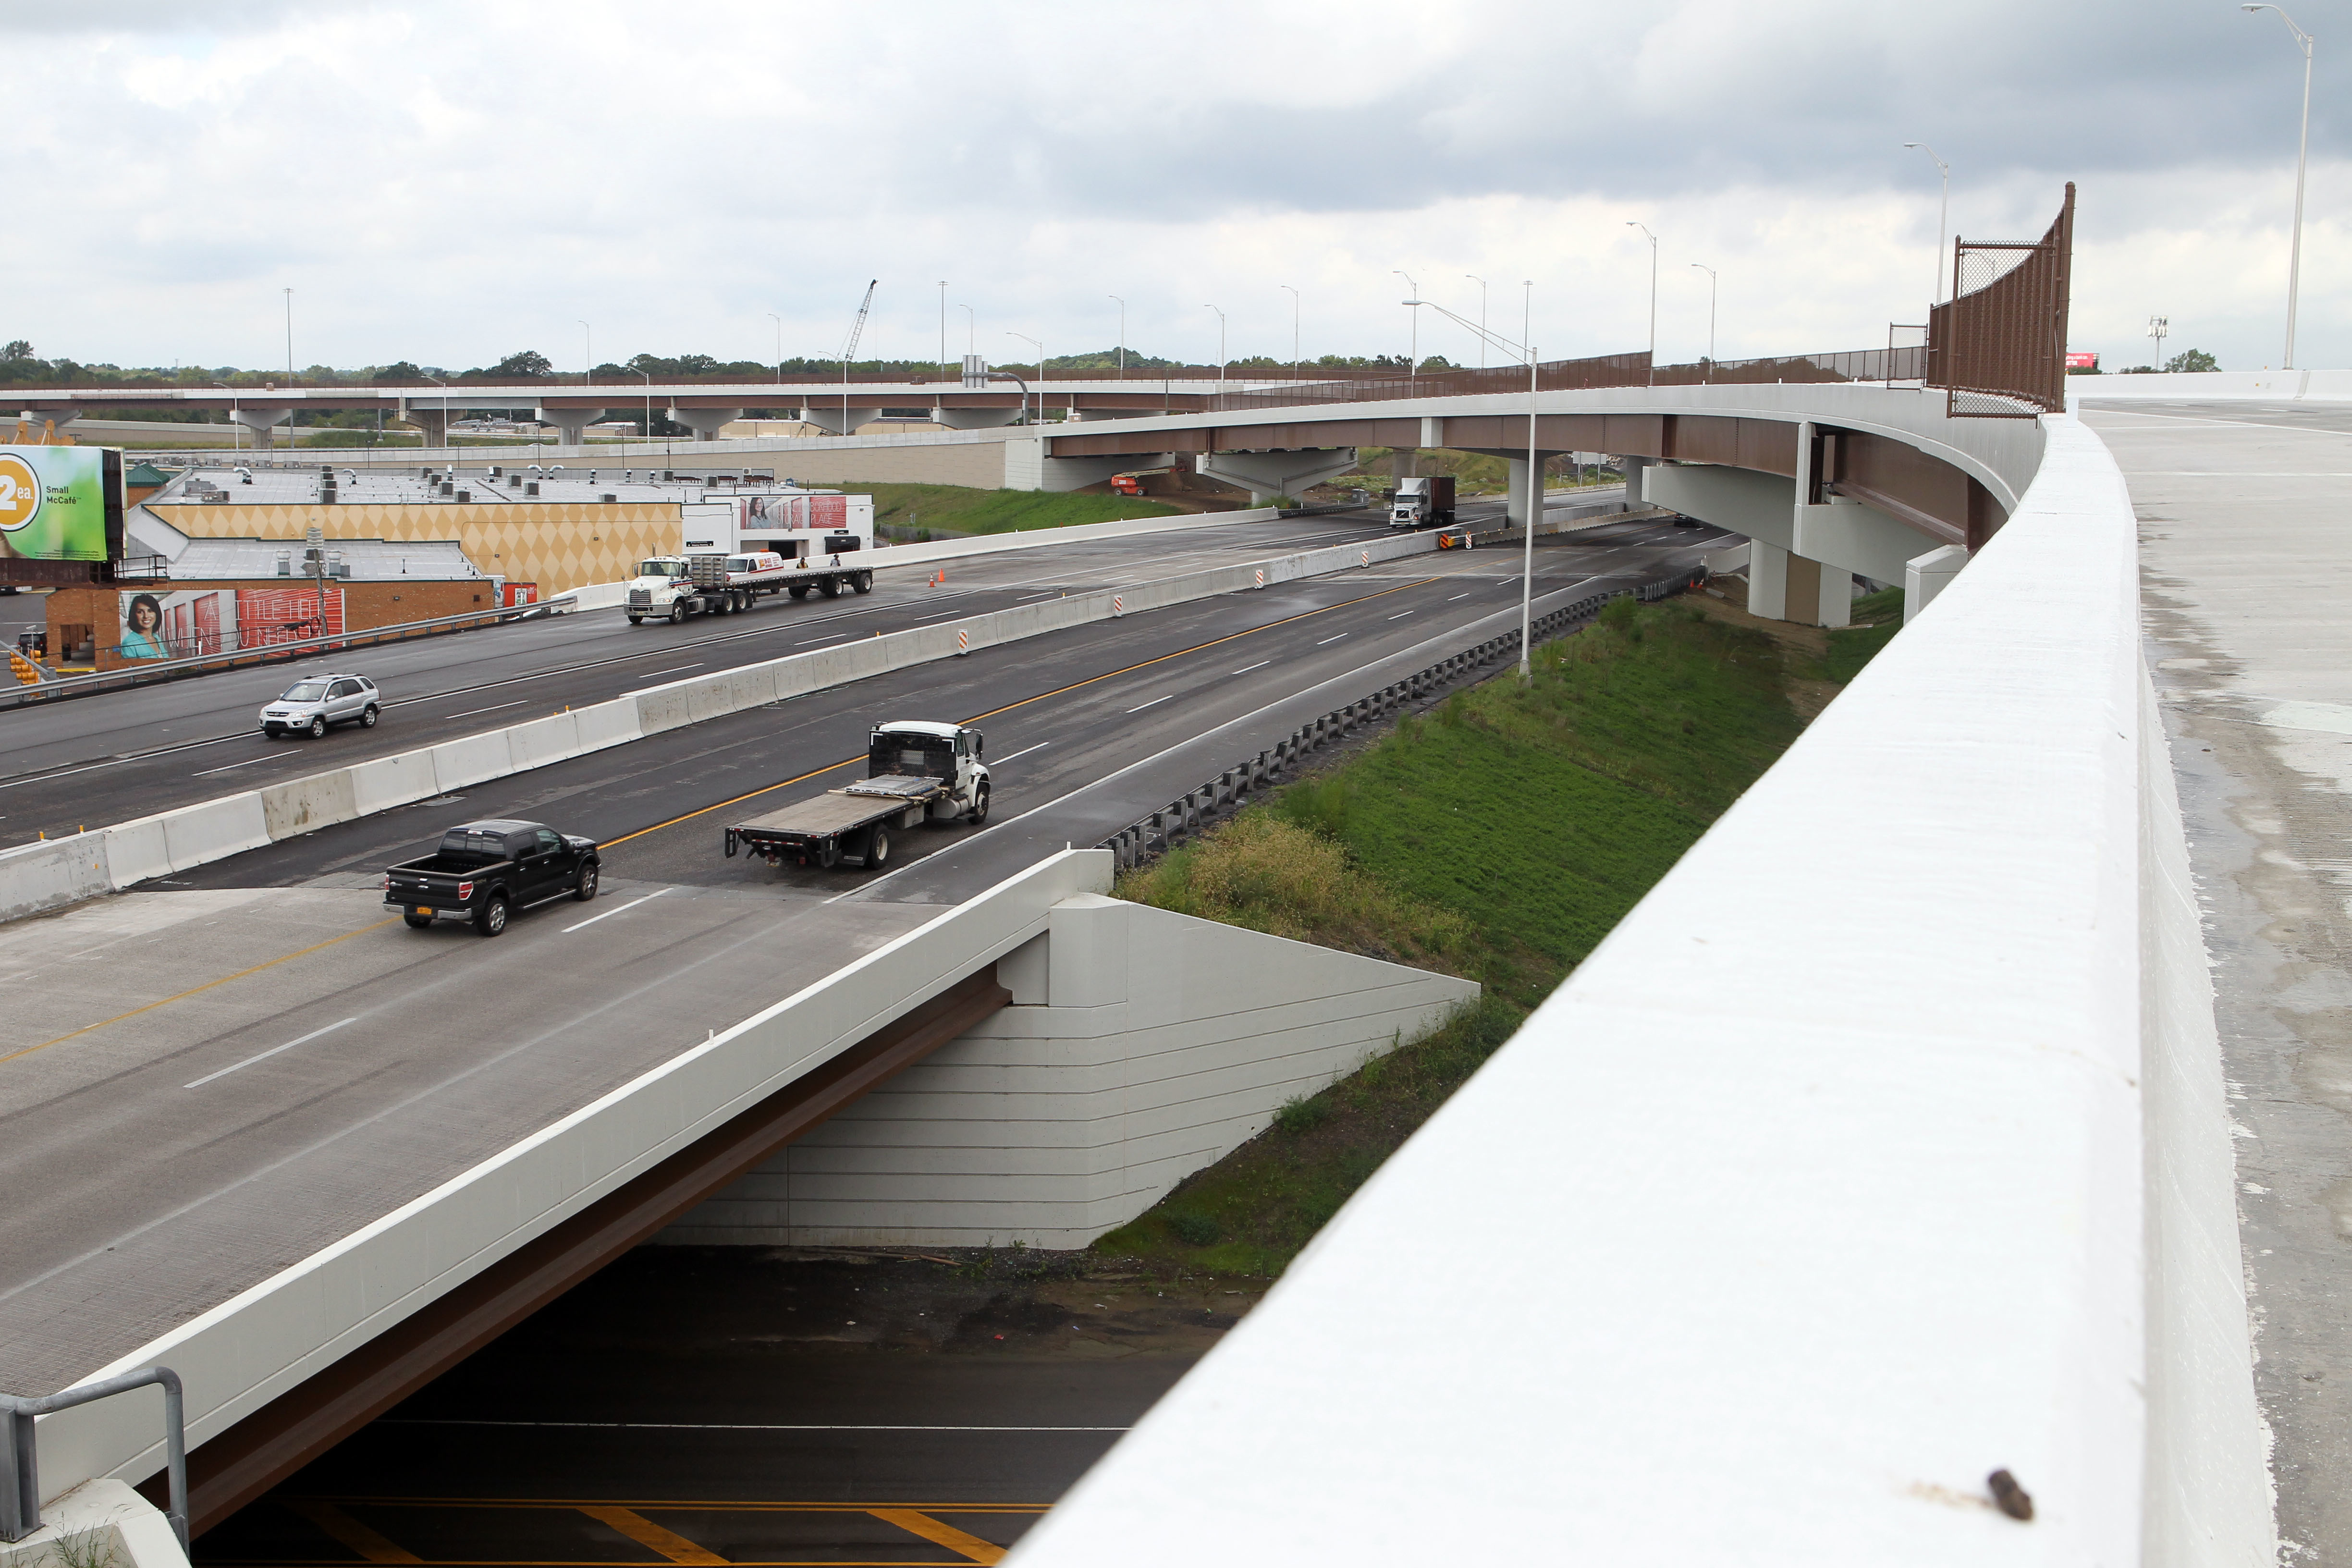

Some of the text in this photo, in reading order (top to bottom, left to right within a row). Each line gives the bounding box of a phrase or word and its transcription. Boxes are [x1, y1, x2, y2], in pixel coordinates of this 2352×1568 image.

[17, 487, 34, 499] ea.
[46, 486, 69, 494] Small
[47, 496, 76, 504] McCafé
[776, 513, 832, 525] STORAG PLACE
[204, 600, 216, 620] A
[234, 600, 282, 620] ITTLE
[167, 627, 212, 648] WHEN
